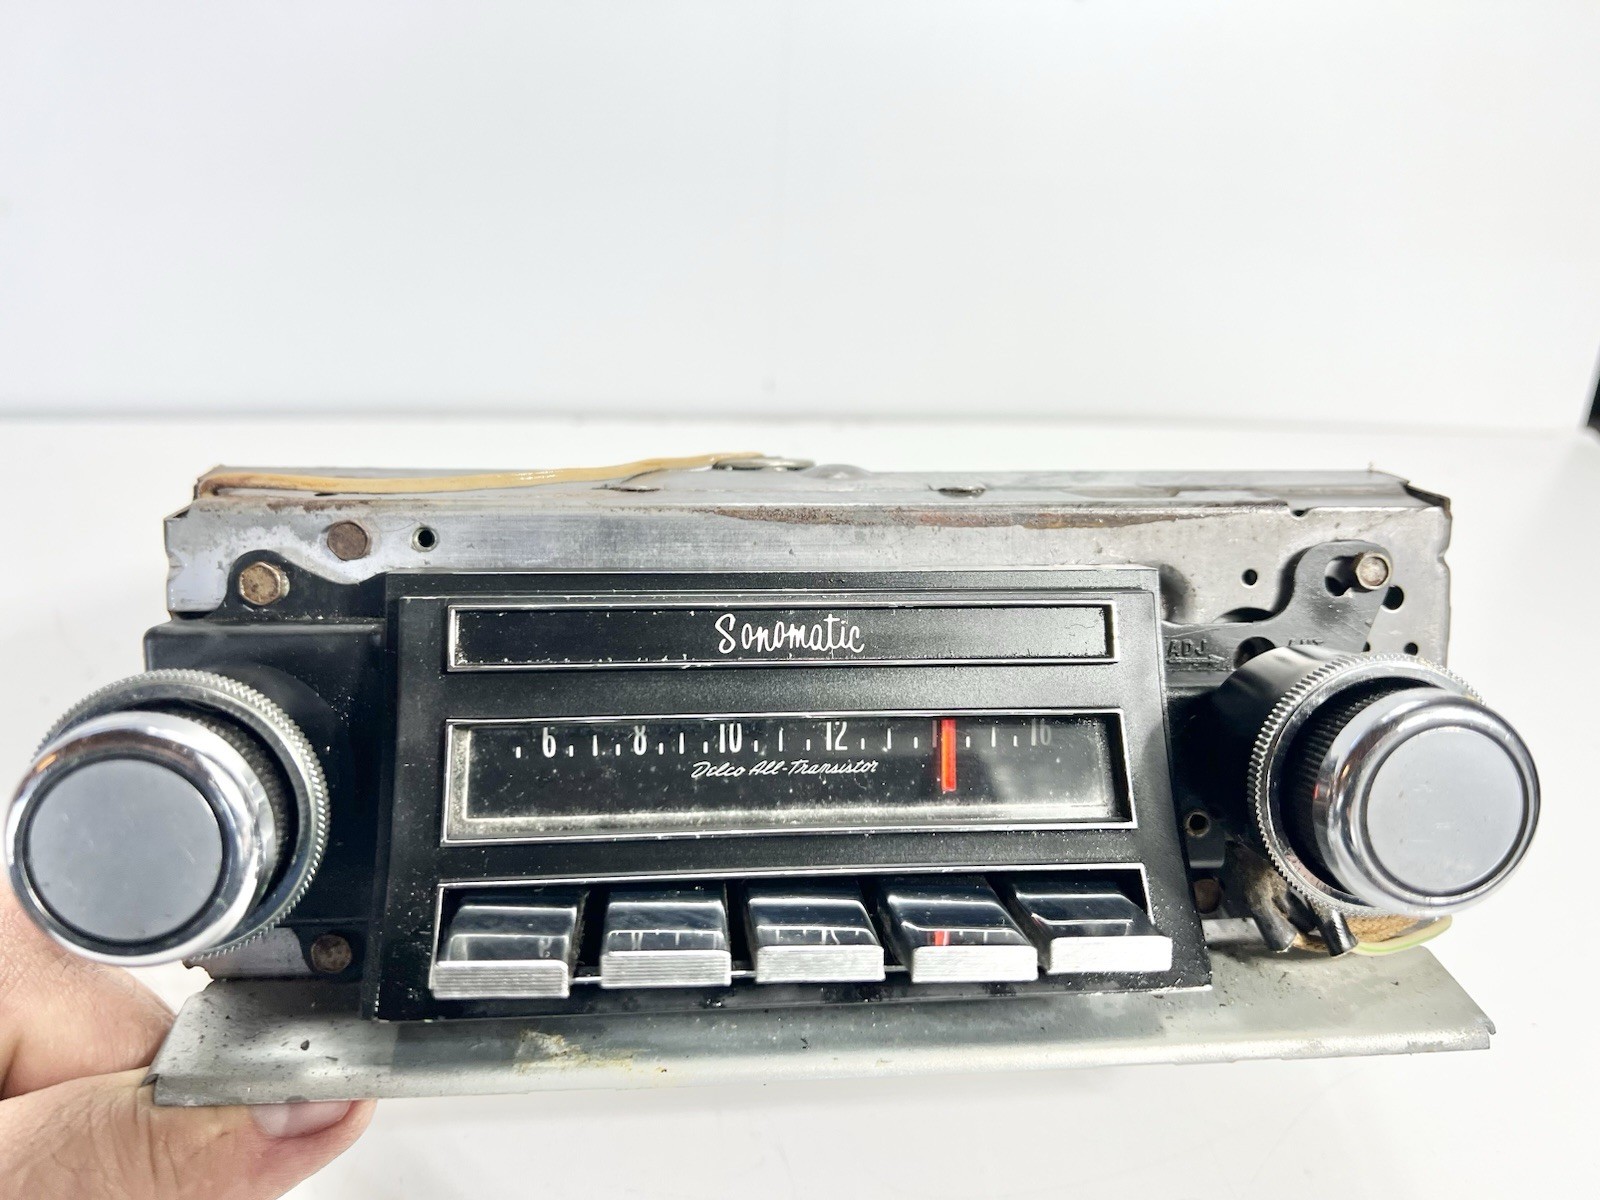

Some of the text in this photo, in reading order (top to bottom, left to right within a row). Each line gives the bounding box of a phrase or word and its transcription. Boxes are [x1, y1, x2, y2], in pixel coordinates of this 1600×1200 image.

[714, 613, 865, 654] Sonomatic
[542, 726, 557, 758] 6
[633, 725, 647, 756] 8
[719, 723, 742, 753] 10
[826, 721, 848, 751] 12
[1031, 718, 1051, 747] 16
[691, 759, 879, 778] Delco All-Transistor
